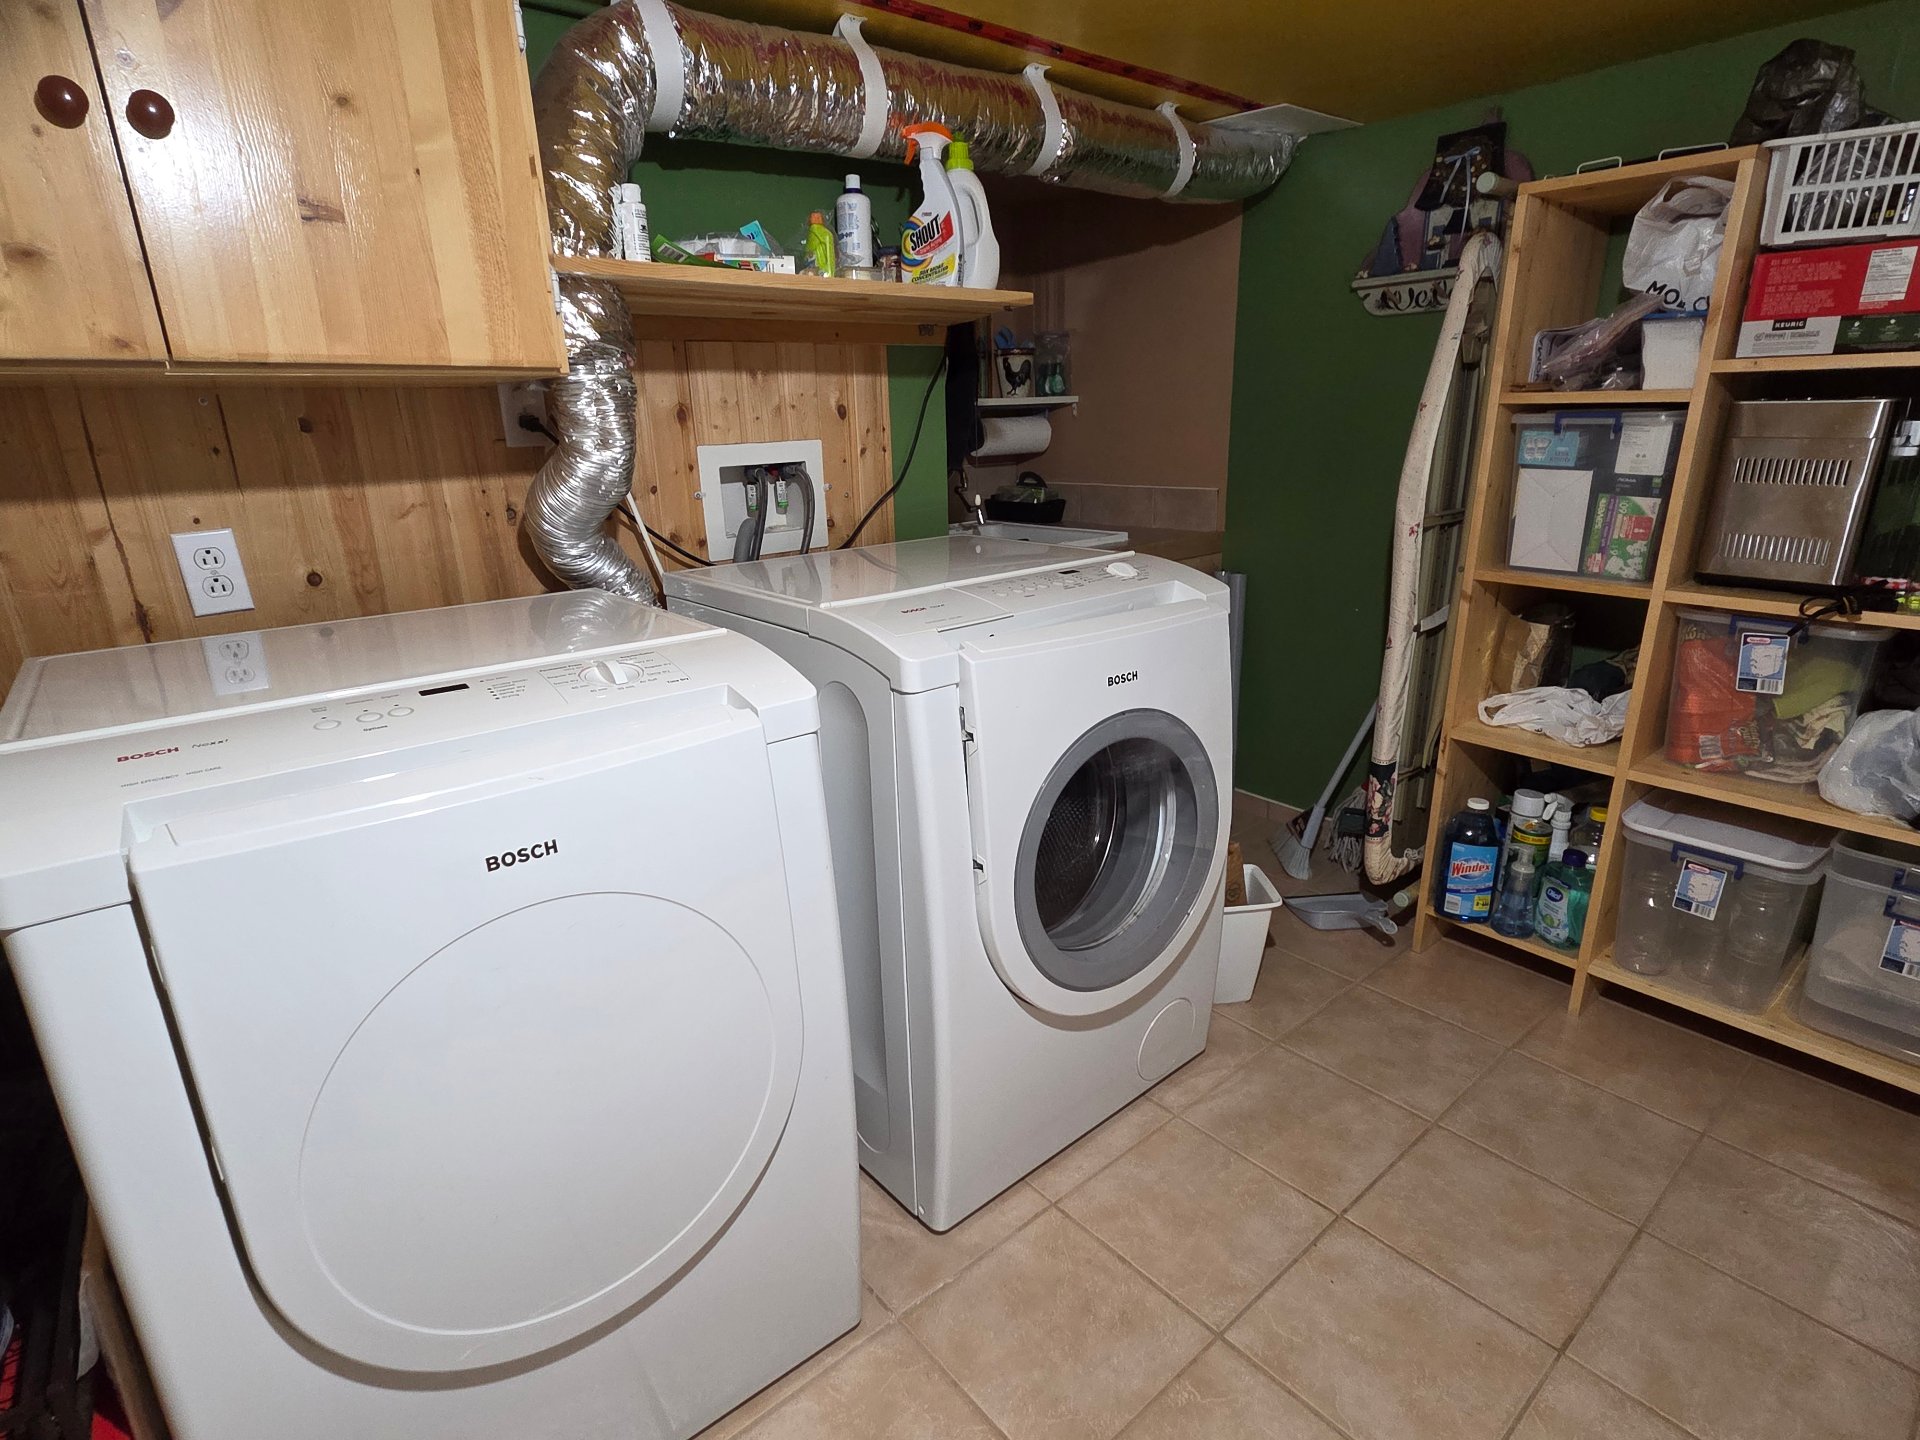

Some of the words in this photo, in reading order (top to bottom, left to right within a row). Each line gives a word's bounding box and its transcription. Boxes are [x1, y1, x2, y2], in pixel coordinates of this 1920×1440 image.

[909, 213, 941, 252] SHOUT
[1774, 320, 1805, 329] KEURIG
[1107, 670, 1138, 687] BOSCH
[116, 746, 180, 763] BOSCH
[485, 838, 559, 873] BOSCH
[1451, 862, 1491, 877] Windex
